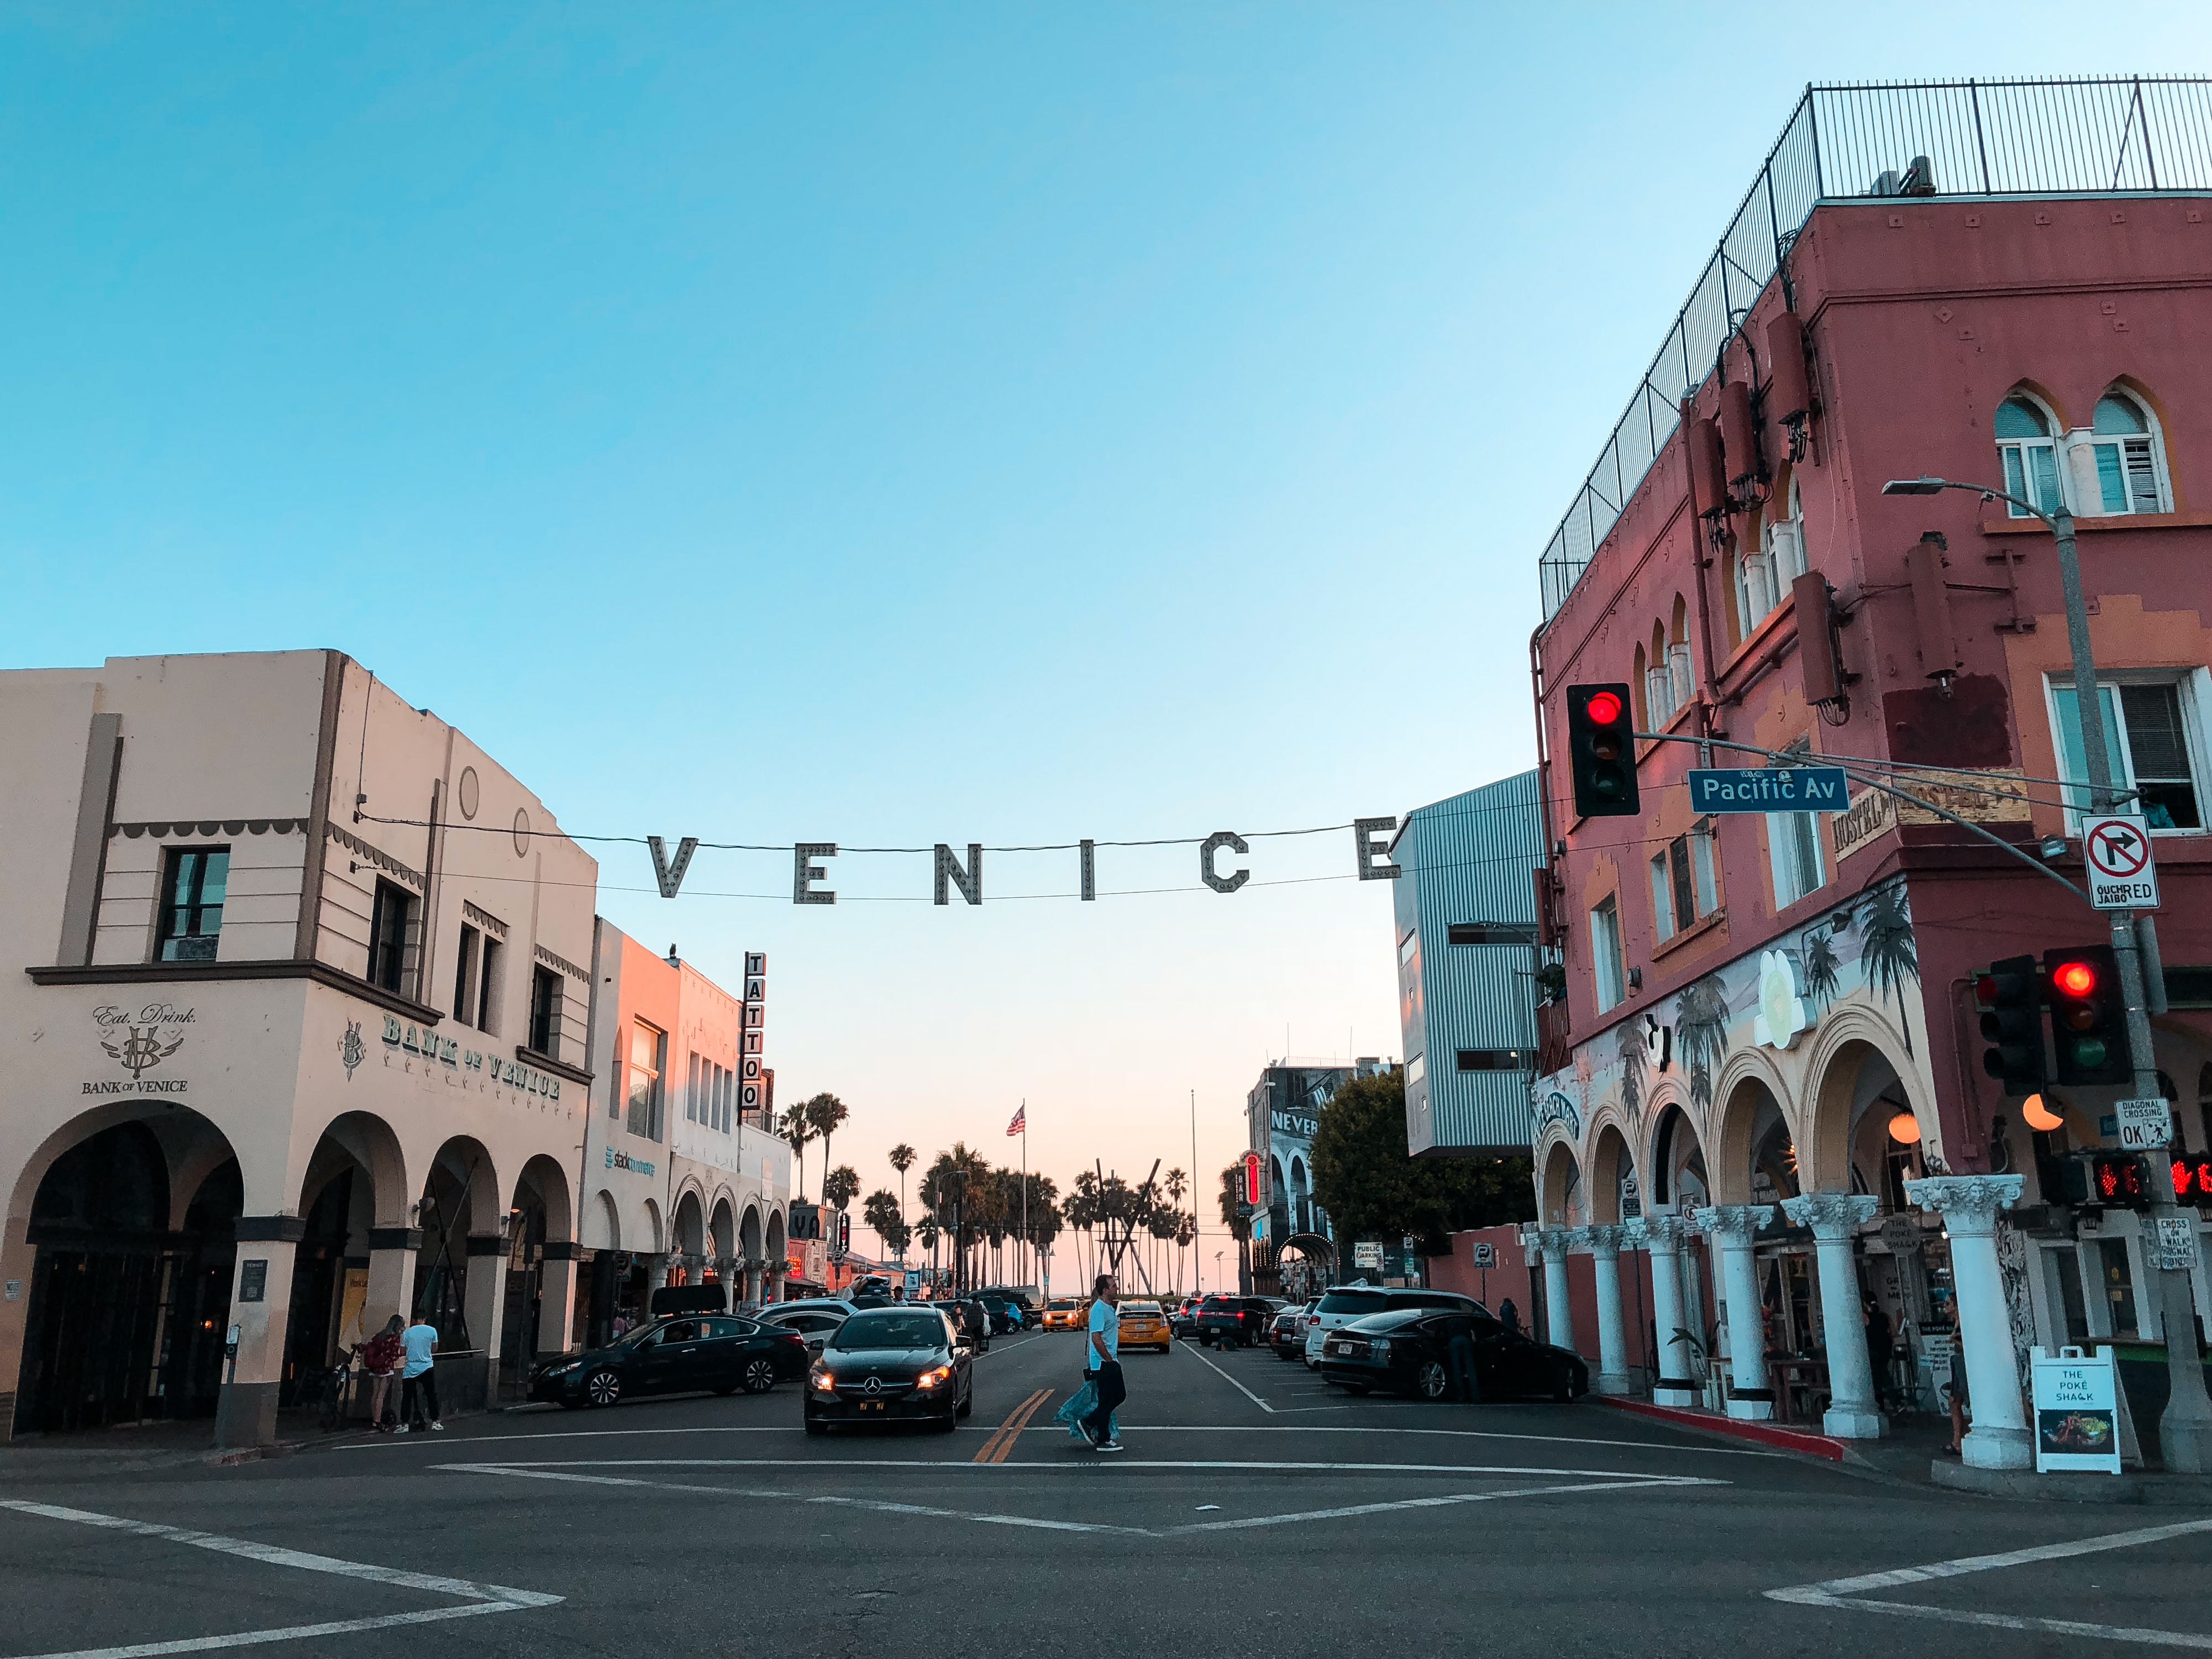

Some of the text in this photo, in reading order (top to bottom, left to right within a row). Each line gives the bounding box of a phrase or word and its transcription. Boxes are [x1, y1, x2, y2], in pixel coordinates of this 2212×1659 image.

[1703, 778, 1835, 800] Pacific Av
[1832, 794, 1882, 853] HOSTEL
[647, 816, 1401, 905] VENICE
[2123, 884, 2152, 898] RED
[138, 1004, 196, 1023] Drink.
[744, 956, 761, 1104] TATTOO
[382, 1014, 458, 1065] BANK
[488, 1052, 559, 1100] VENICE
[82, 1080, 188, 1094] BANK OF VENICE
[2122, 1100, 2161, 1110] DIAGONAL
[2124, 1108, 2162, 1118] CROSSING
[2123, 1125, 2143, 1144] OK
[1891, 1220, 1908, 1228] THE
[2161, 1220, 2187, 1229] CROSS
[2062, 1371, 2083, 1379] THE
[2060, 1380, 2088, 1390] POKÉ
[2056, 1393, 2094, 1401] SHACK
